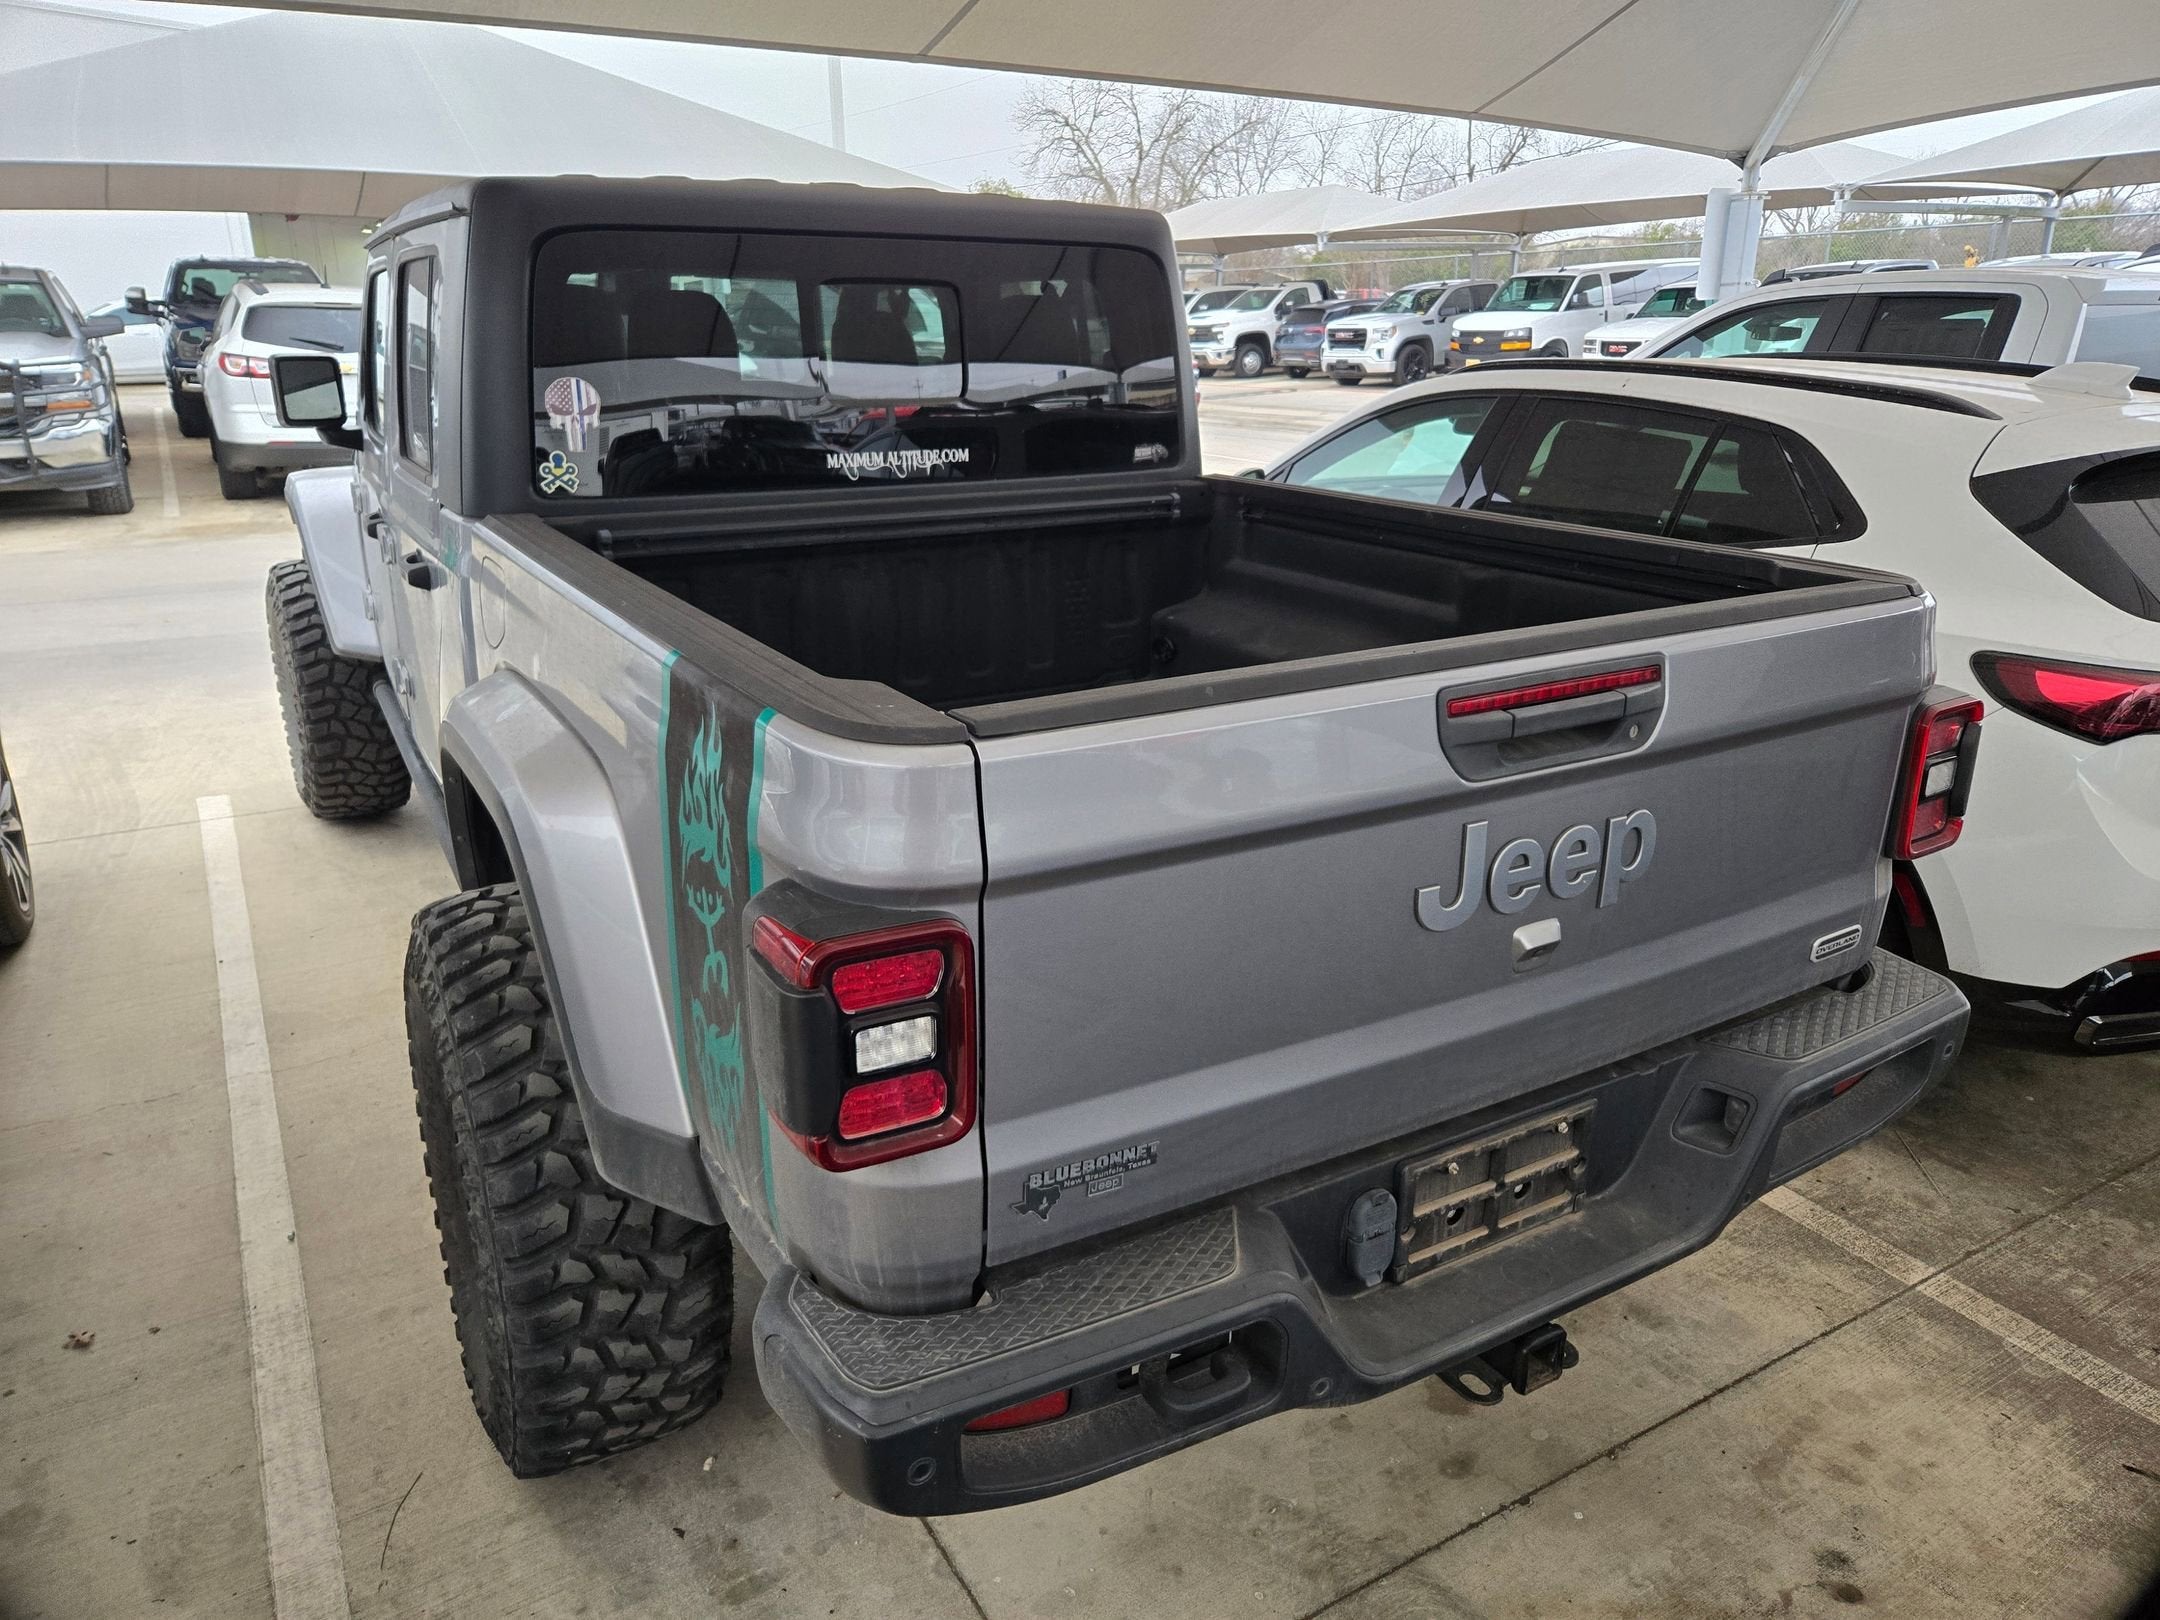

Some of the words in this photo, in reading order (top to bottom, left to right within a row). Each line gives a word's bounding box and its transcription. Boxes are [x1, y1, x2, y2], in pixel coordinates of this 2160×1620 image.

[827, 452, 893, 481] MAXIMUM
[1415, 809, 1657, 932] Jeep
[1815, 933, 1860, 955] OVERLAND
[1029, 1141, 1160, 1189] BLUEBONNET
[1063, 1178, 1083, 1188] New
[1128, 1158, 1152, 1170] Texas
[1091, 1178, 1120, 1193] Jeep
